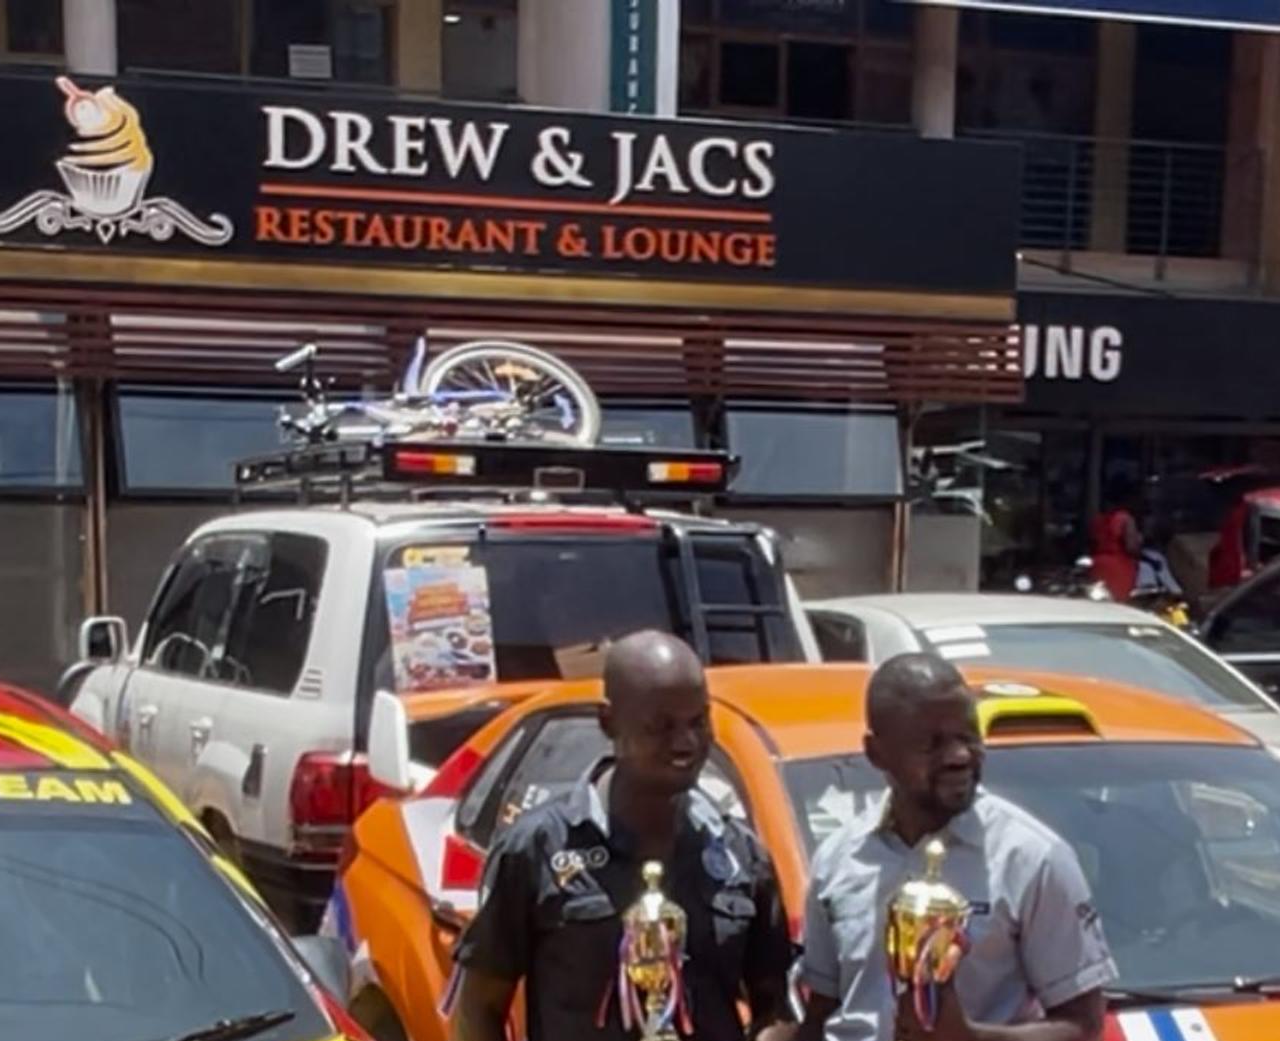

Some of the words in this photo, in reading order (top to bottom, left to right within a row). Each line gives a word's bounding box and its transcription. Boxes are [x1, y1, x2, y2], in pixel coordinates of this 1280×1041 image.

[261, 105, 509, 181] DREW
[531, 126, 593, 187] &
[609, 131, 776, 206] JACS
[255, 206, 545, 255] RESTAURANT
[557, 222, 594, 258] &
[601, 224, 777, 267] LOUNGE
